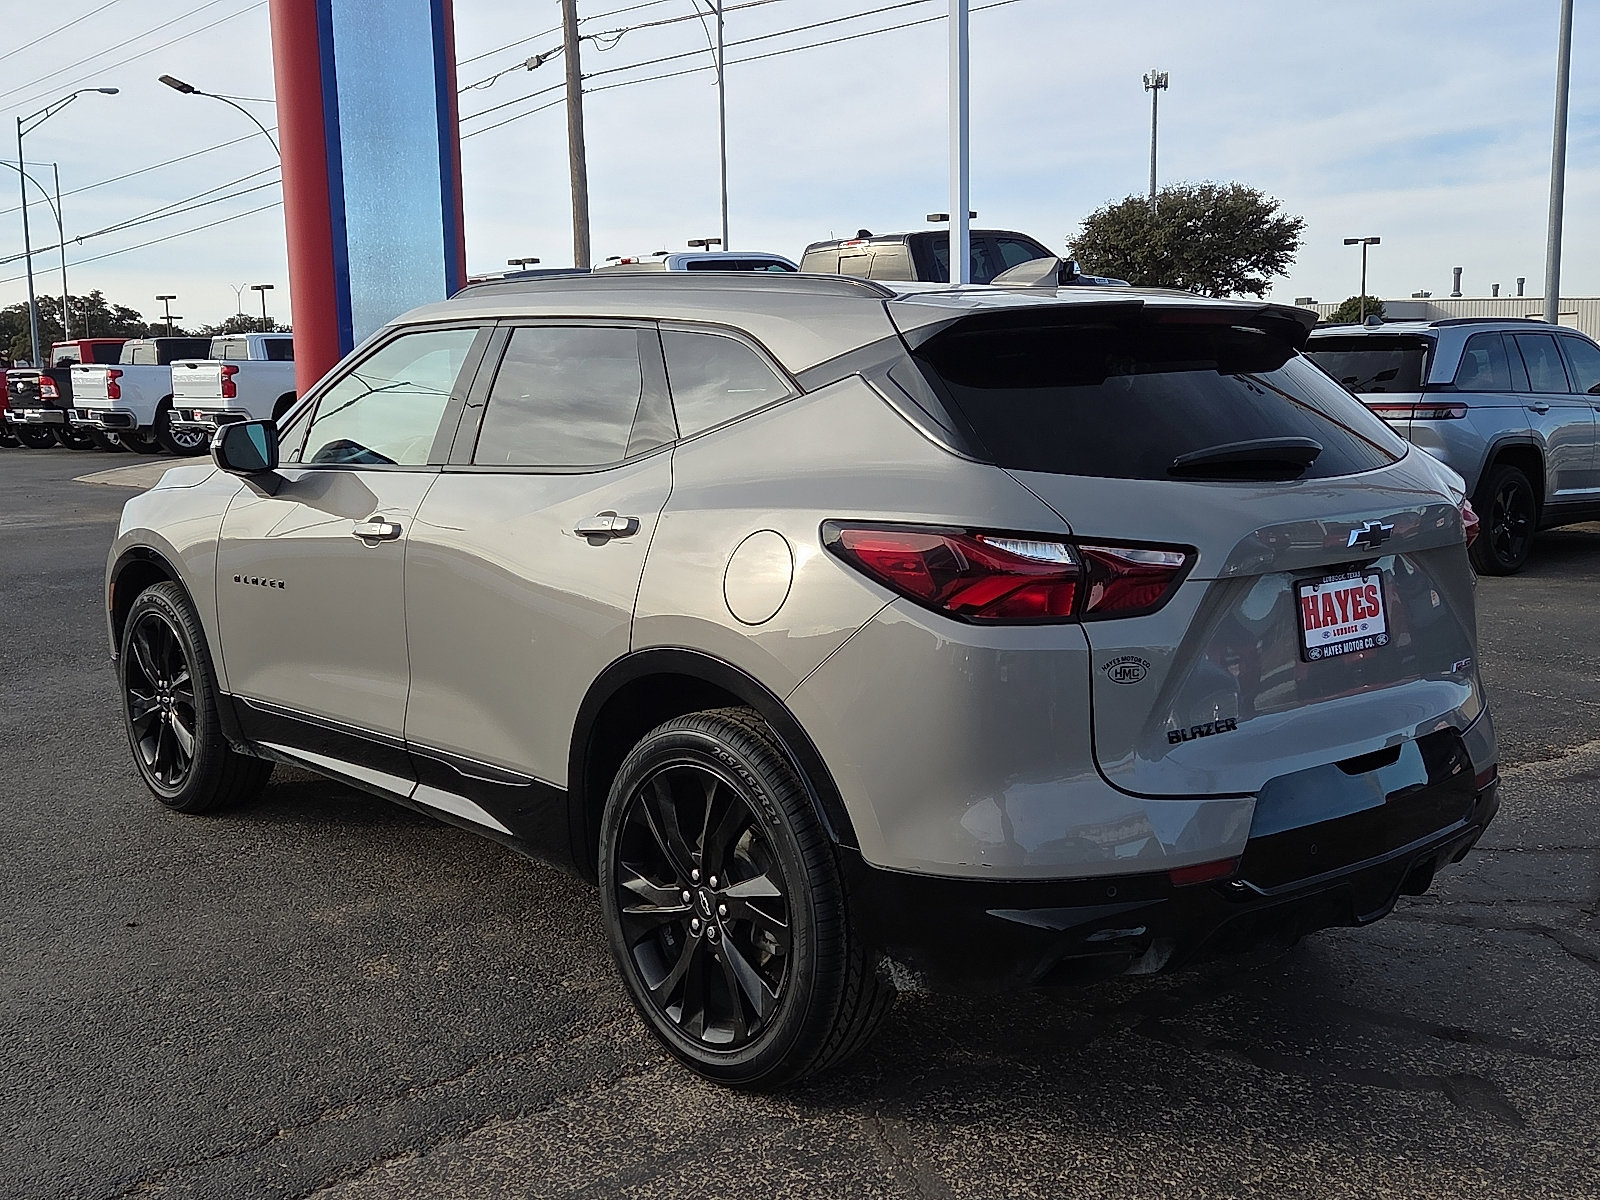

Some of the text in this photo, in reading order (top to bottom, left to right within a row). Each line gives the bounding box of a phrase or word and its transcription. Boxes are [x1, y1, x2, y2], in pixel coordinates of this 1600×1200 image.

[233, 573, 285, 589] BLAZER
[1301, 584, 1380, 631] HAYES
[1323, 645, 1343, 657] HAYES
[1343, 639, 1364, 653] MOTOR
[1364, 637, 1375, 649] CO.
[1101, 655, 1151, 672] HAYES MOTOR CO.
[1114, 665, 1140, 681] HMC
[1167, 716, 1239, 744] BLAZER
[710, 746, 781, 826] 265/45ZR21
